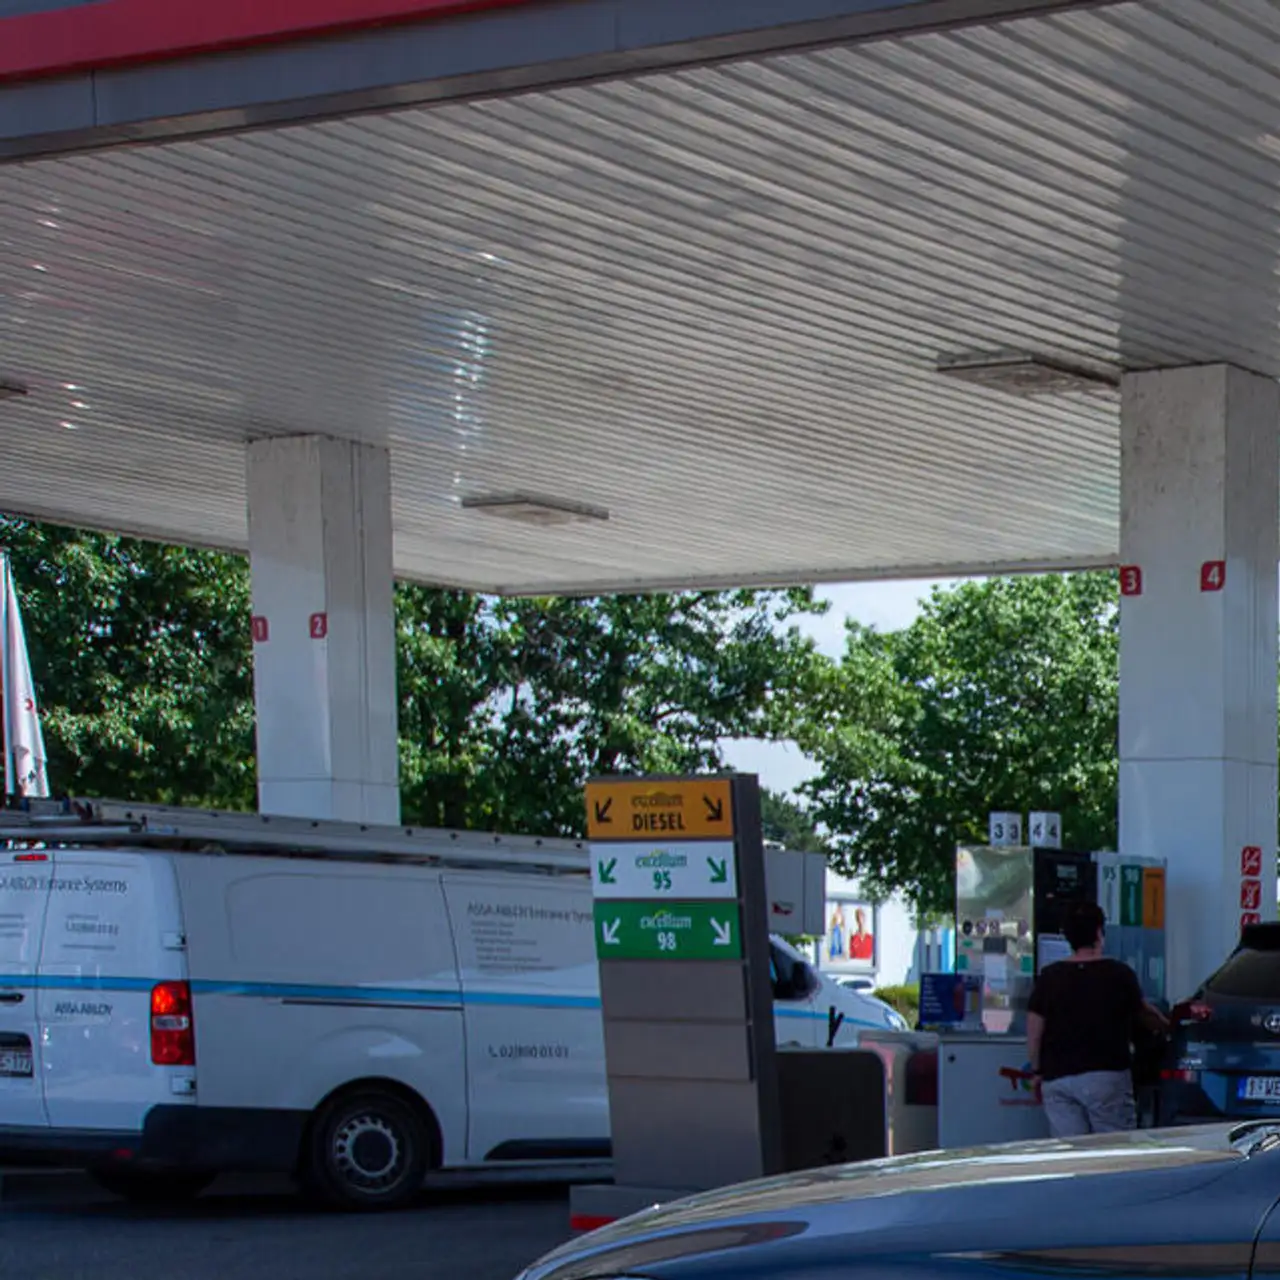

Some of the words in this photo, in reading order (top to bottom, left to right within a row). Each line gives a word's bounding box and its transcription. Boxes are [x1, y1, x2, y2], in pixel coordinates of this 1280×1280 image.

[1126, 570, 1137, 592] 3
[1207, 565, 1220, 588] 4
[632, 813, 686, 832] DIESEL
[993, 822, 1004, 839] 3
[653, 871, 672, 890] 95
[657, 931, 677, 951] 98
